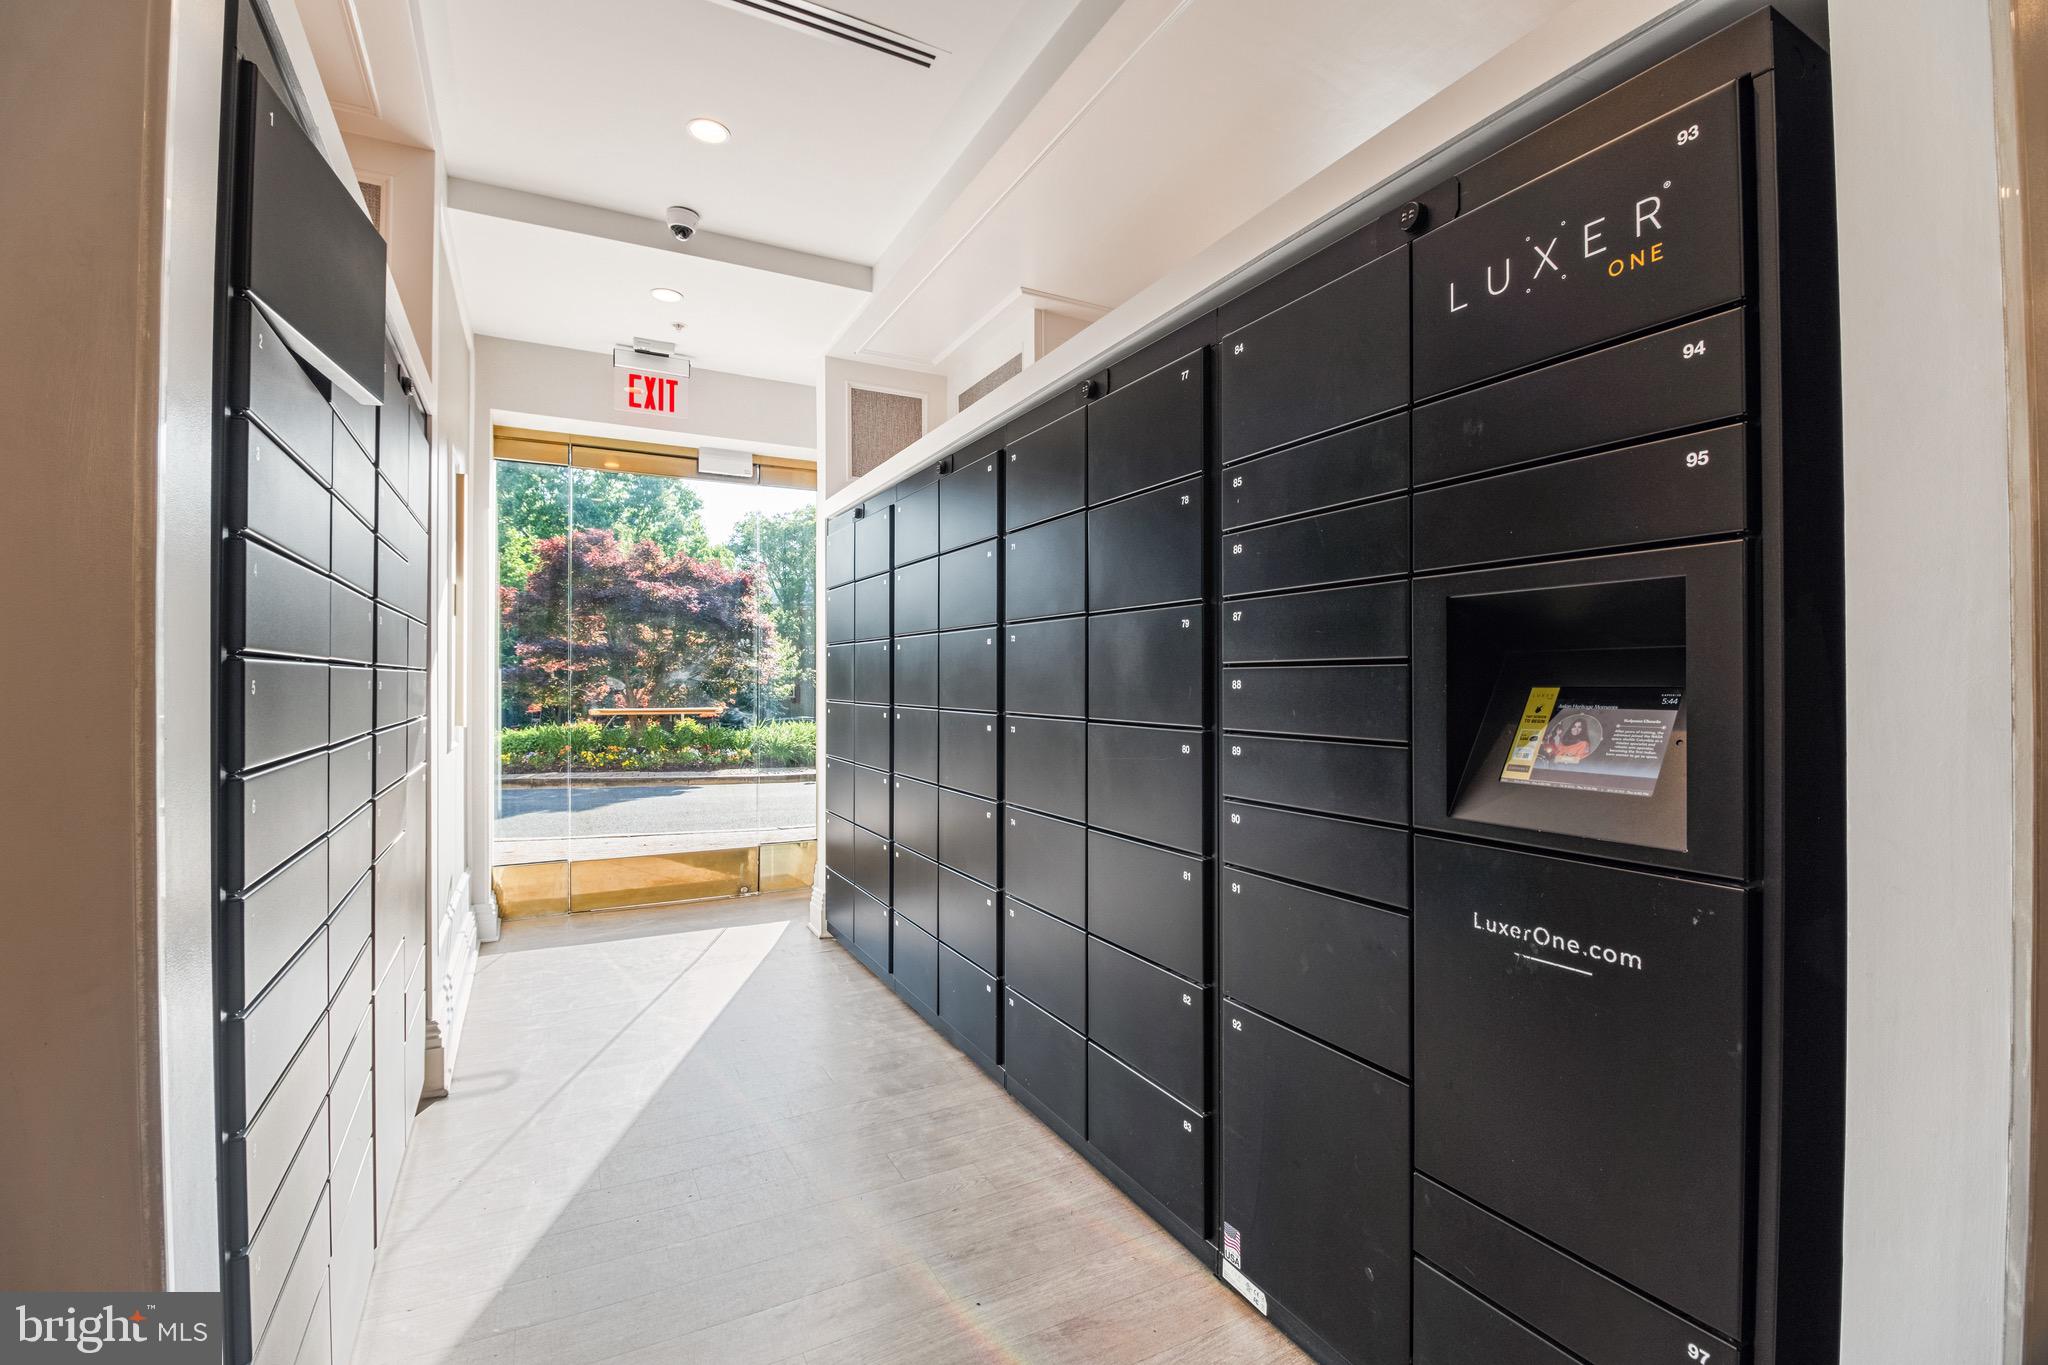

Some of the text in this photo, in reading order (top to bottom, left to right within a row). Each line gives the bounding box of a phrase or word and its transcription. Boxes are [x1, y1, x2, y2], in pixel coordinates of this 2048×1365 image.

[1676, 124, 1700, 146] 93
[1450, 195, 1662, 313] LUXER
[1608, 242, 1664, 277] ONE
[1234, 342, 1244, 355] 84
[1682, 339, 1707, 359] 94
[1181, 369, 1190, 381] 77
[628, 373, 679, 413] EXIT
[1686, 449, 1710, 468] 95
[1232, 476, 1243, 488] 85
[1180, 495, 1190, 506] 78
[1232, 543, 1243, 555] 86
[1232, 611, 1242, 622] 87
[1181, 618, 1190, 629] 79
[1231, 679, 1242, 690] 88
[1661, 697, 1678, 705] 5:44
[1181, 744, 1191, 754] 80
[1231, 745, 1242, 756] 89
[1230, 813, 1241, 825] 90
[1182, 870, 1191, 881] 81
[1231, 882, 1241, 894] 91
[1474, 911, 1642, 970] LuxerOne.com
[1182, 993, 1192, 1006] 82
[1232, 1018, 1242, 1032] 92
[1183, 1119, 1192, 1133] 83
[1225, 1249, 1240, 1268] USA
[1687, 1343, 1711, 1365] 97
